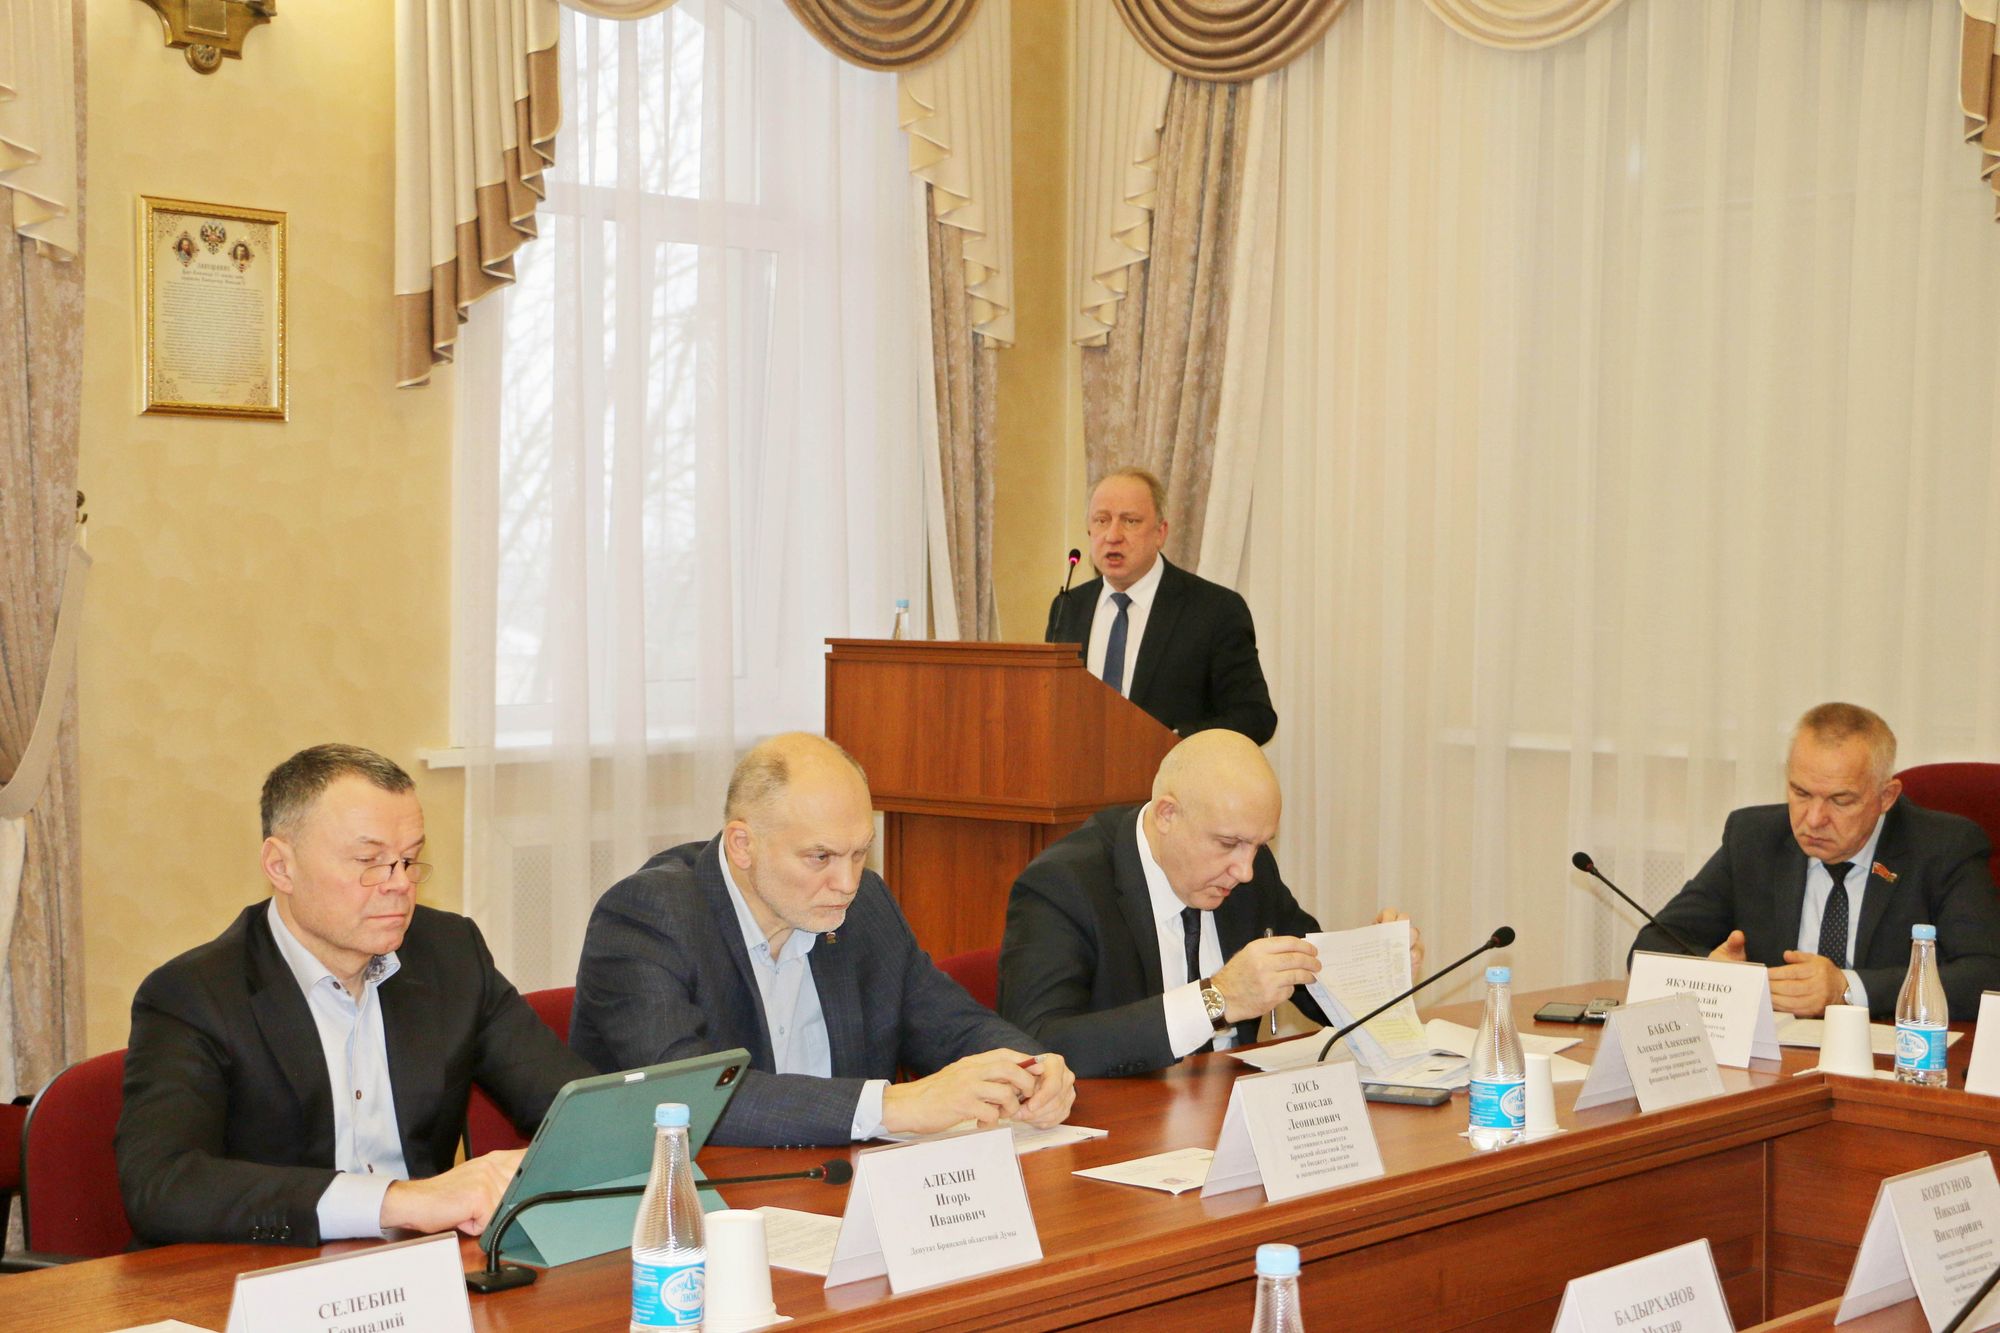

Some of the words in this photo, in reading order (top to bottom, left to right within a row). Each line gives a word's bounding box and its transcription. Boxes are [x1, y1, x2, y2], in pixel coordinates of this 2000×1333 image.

[1665, 978, 1732, 993] ЯКУШЕНКО
[1647, 1020, 1681, 1036] БАБАСЬ
[1636, 1042, 1663, 1054] Алексей
[1664, 1036, 1701, 1048] Алексеевич
[1291, 1079, 1320, 1095] ЛОСЬ
[1286, 1097, 1333, 1113] Святослав
[1288, 1112, 1341, 1131] Леонидович
[923, 1168, 976, 1189] АЛЕХИН
[1920, 1175, 1972, 1202] КОВТУНОВ
[935, 1192, 971, 1206] Игорь
[929, 1209, 986, 1228] Иванович
[1933, 1199, 1971, 1221] Николай
[1933, 1219, 1984, 1243] Викторович
[911, 1246, 936, 1256] Депутат
[936, 1240, 968, 1251] Брянской
[967, 1233, 999, 1244] областной
[999, 1230, 1017, 1240] Думы
[318, 1287, 405, 1320] СЕЛЕБИН
[1614, 1286, 1695, 1327] БАДЫРХАНОВ
